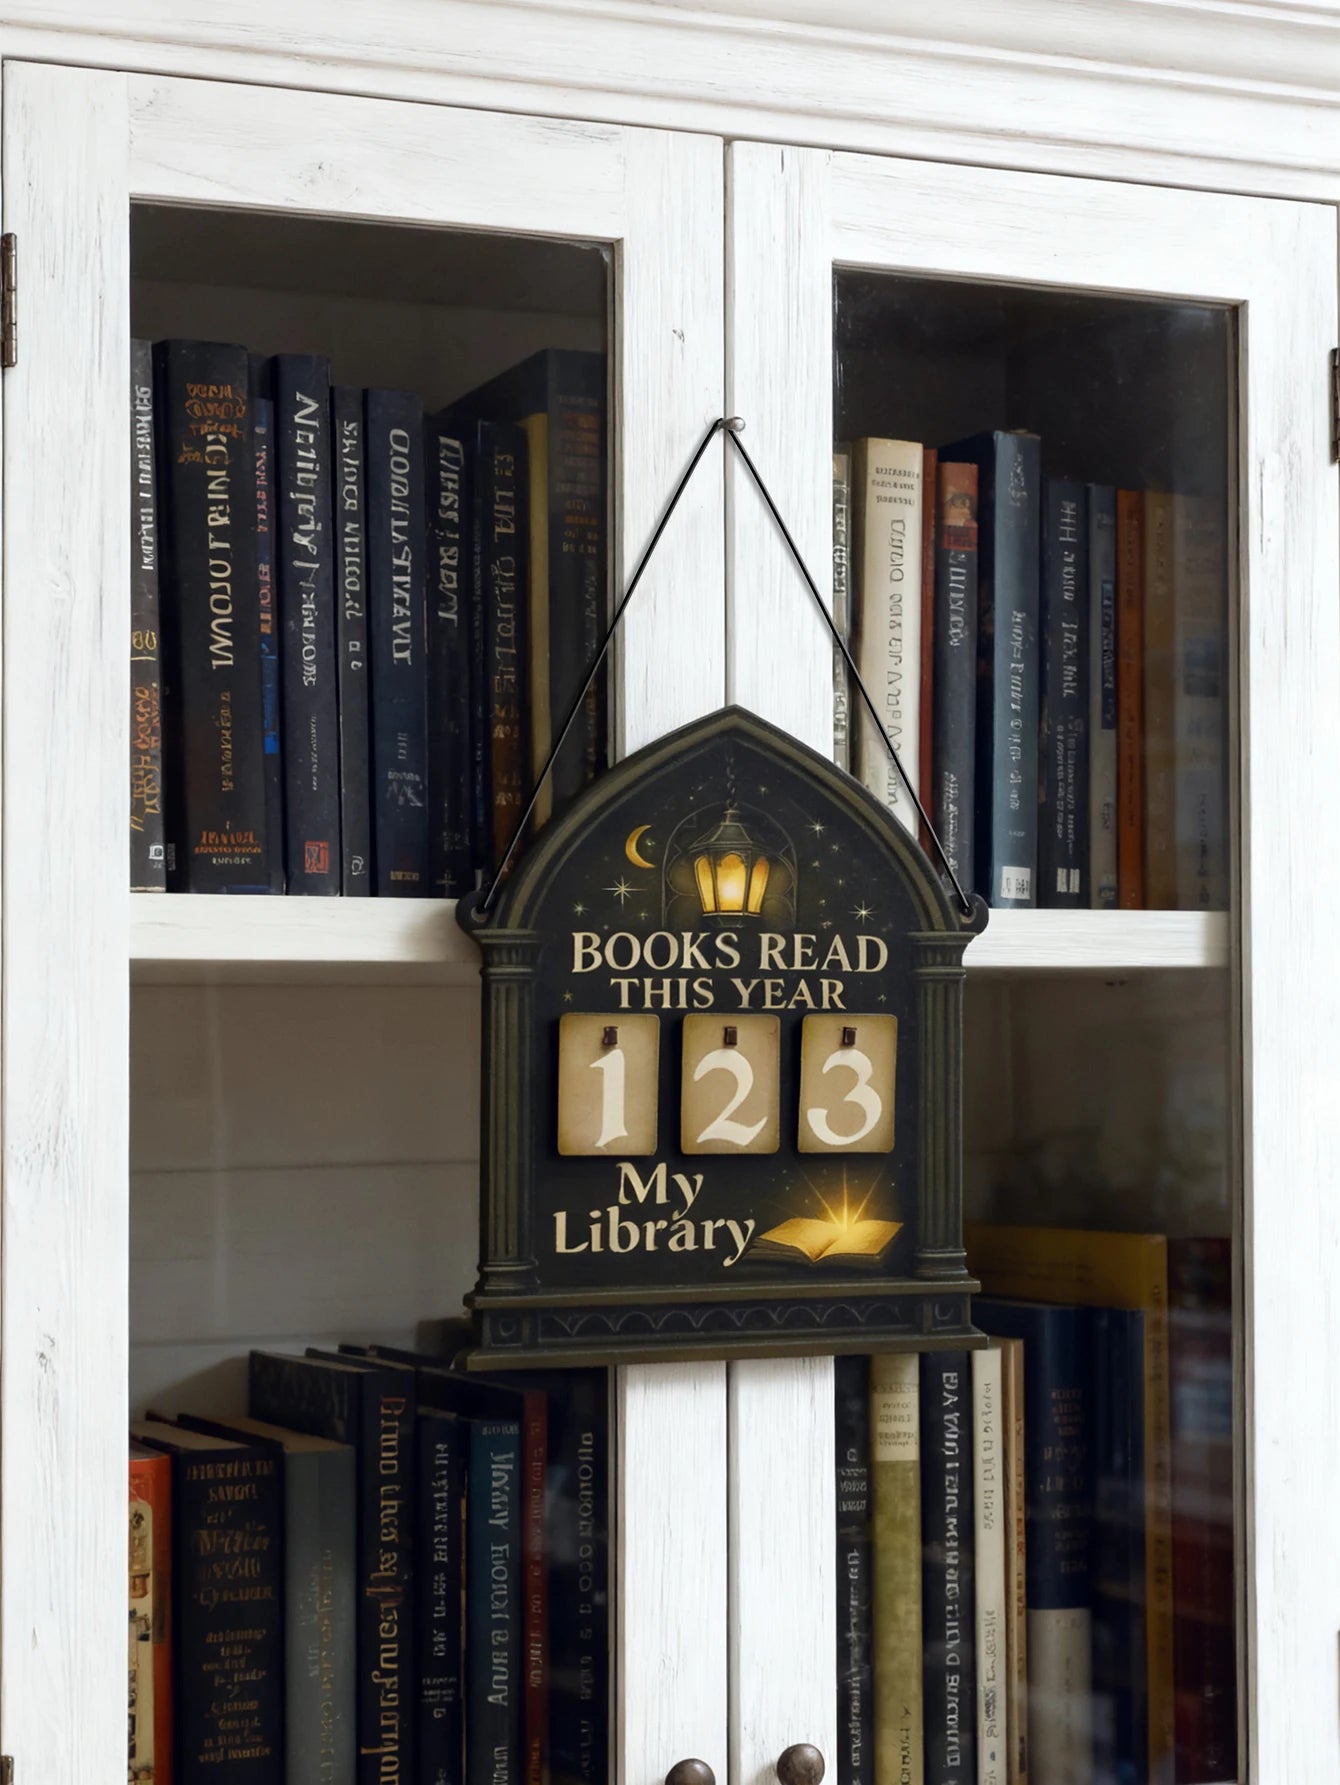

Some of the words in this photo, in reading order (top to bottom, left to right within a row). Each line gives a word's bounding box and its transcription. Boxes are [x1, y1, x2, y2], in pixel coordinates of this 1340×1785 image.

[572, 931, 741, 973] BOOKS
[758, 932, 889, 973] READ
[610, 978, 715, 1009] THIS
[731, 978, 847, 1010] YEAR
[589, 1049, 629, 1148] 1
[693, 1049, 768, 1146] 2
[806, 1049, 882, 1146] 3
[616, 1162, 704, 1221] My
[553, 1206, 756, 1267] Library
